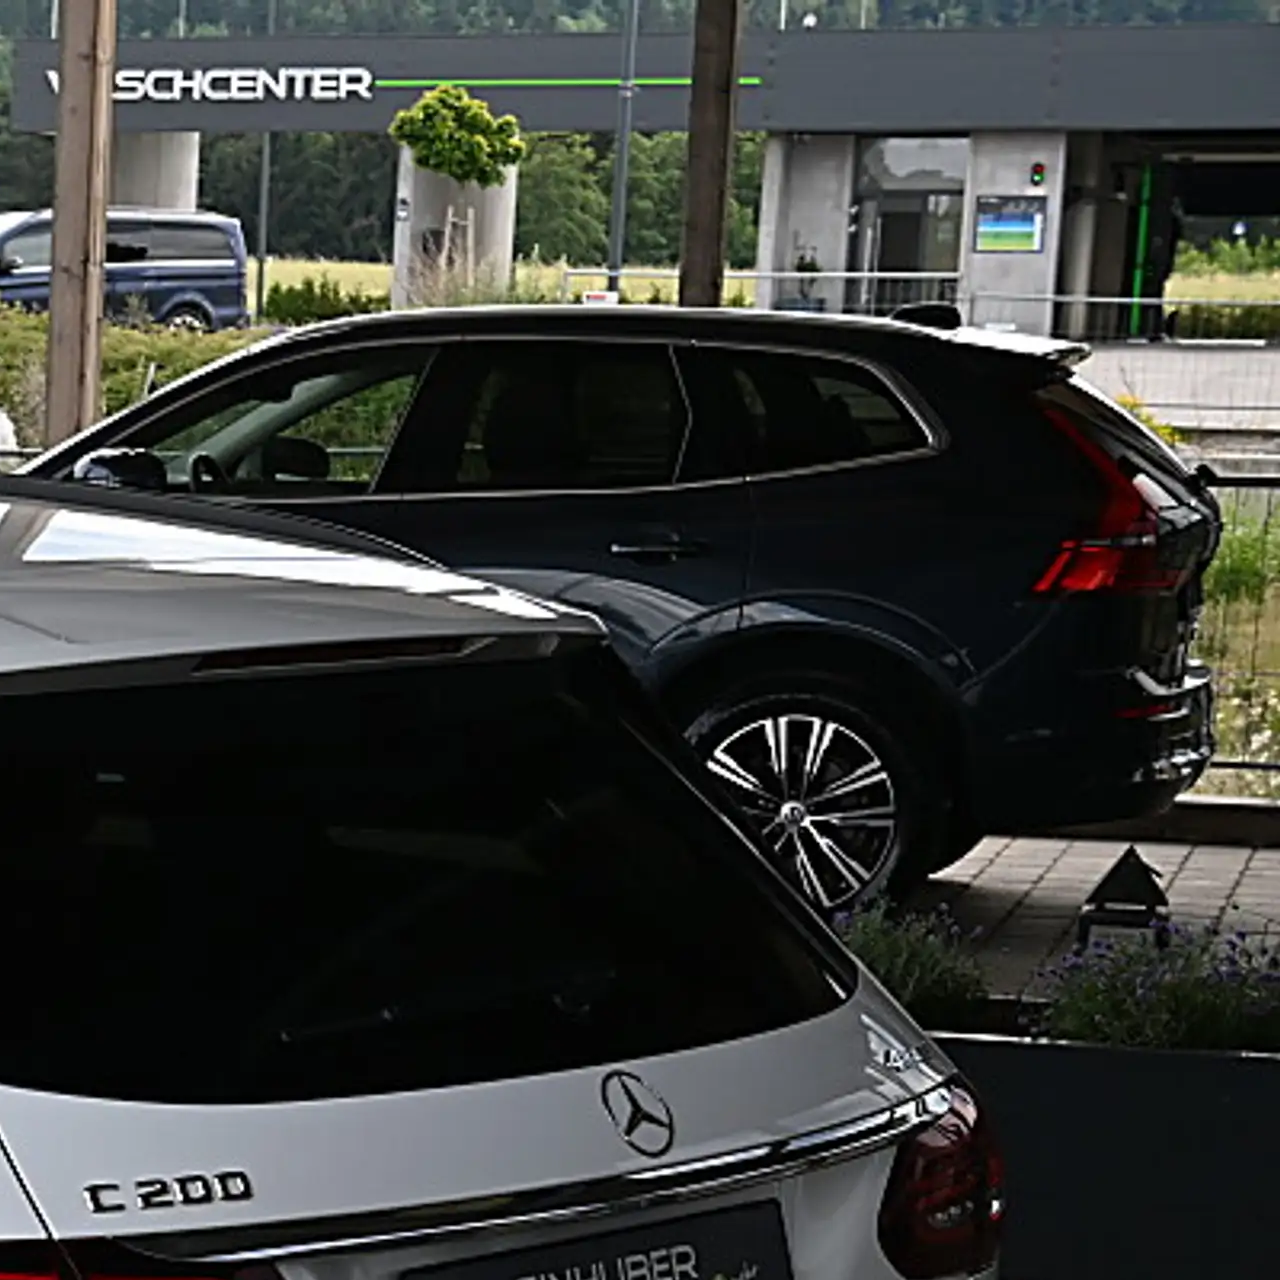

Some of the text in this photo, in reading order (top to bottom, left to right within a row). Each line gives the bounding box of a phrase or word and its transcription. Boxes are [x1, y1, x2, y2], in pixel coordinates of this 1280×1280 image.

[45, 67, 375, 101] SCHCENTER
[83, 1171, 254, 1214] C 200
